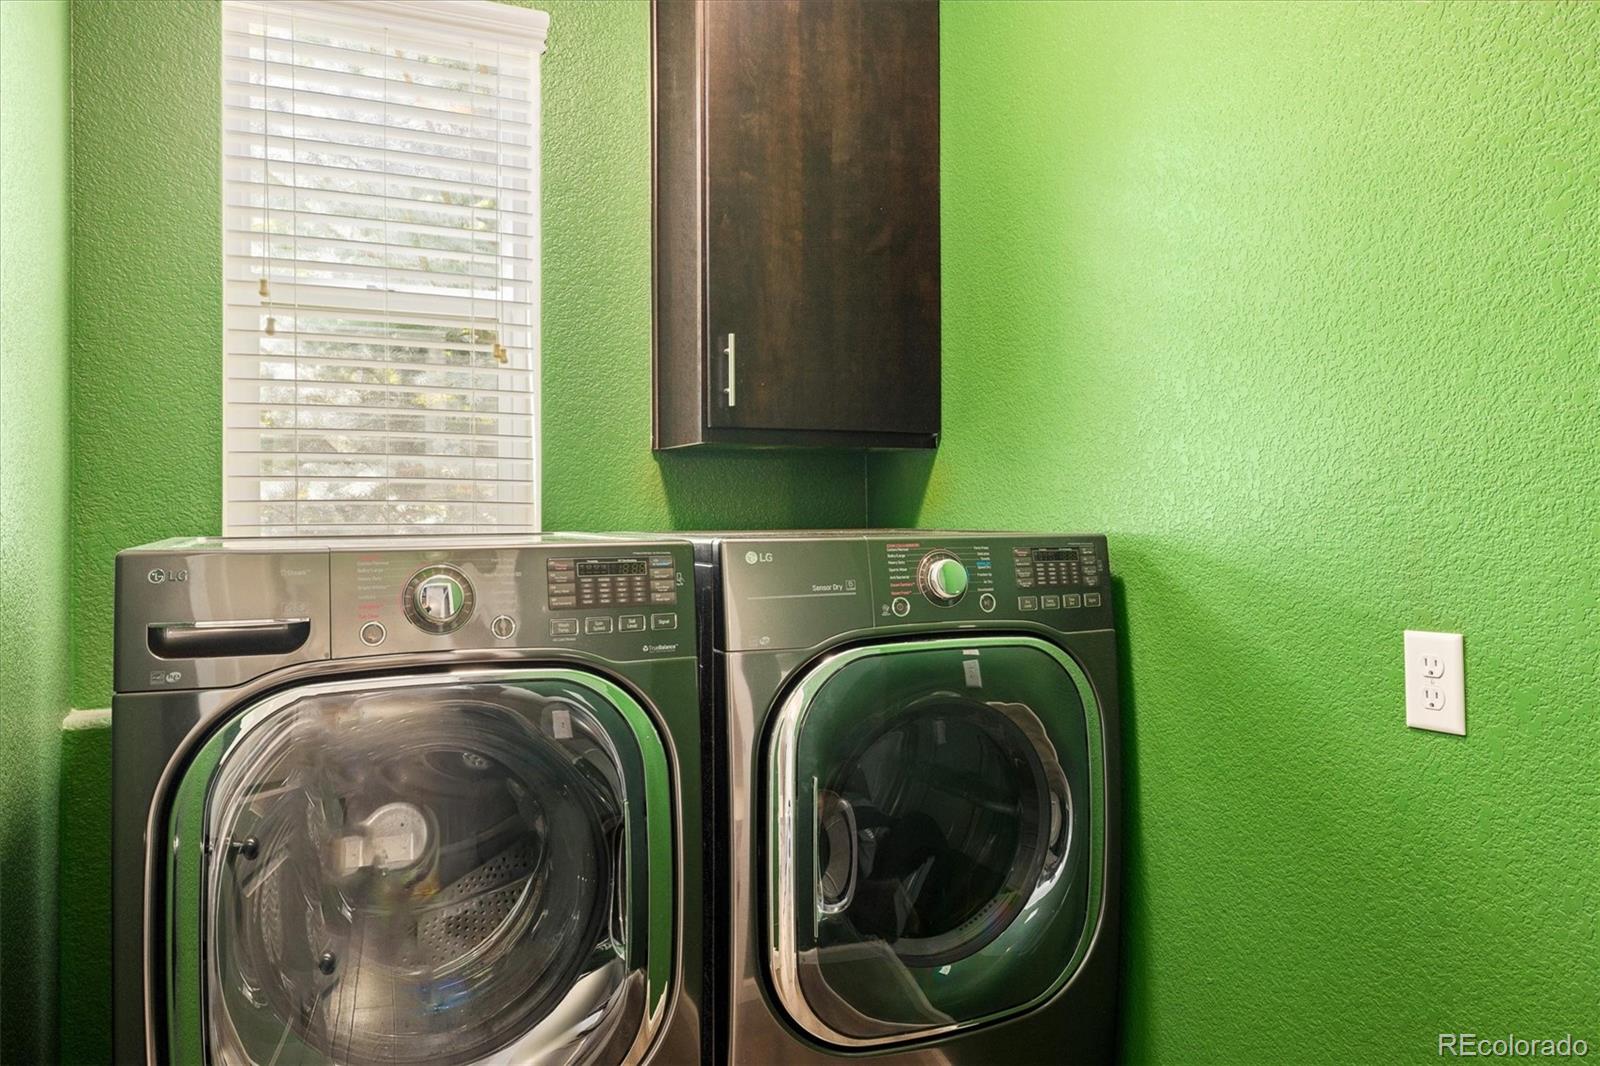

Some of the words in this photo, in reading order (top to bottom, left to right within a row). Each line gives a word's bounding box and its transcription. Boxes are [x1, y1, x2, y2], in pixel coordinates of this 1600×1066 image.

[759, 553, 773, 562] LG
[168, 570, 188, 581] LG
[833, 583, 843, 591] Dry
